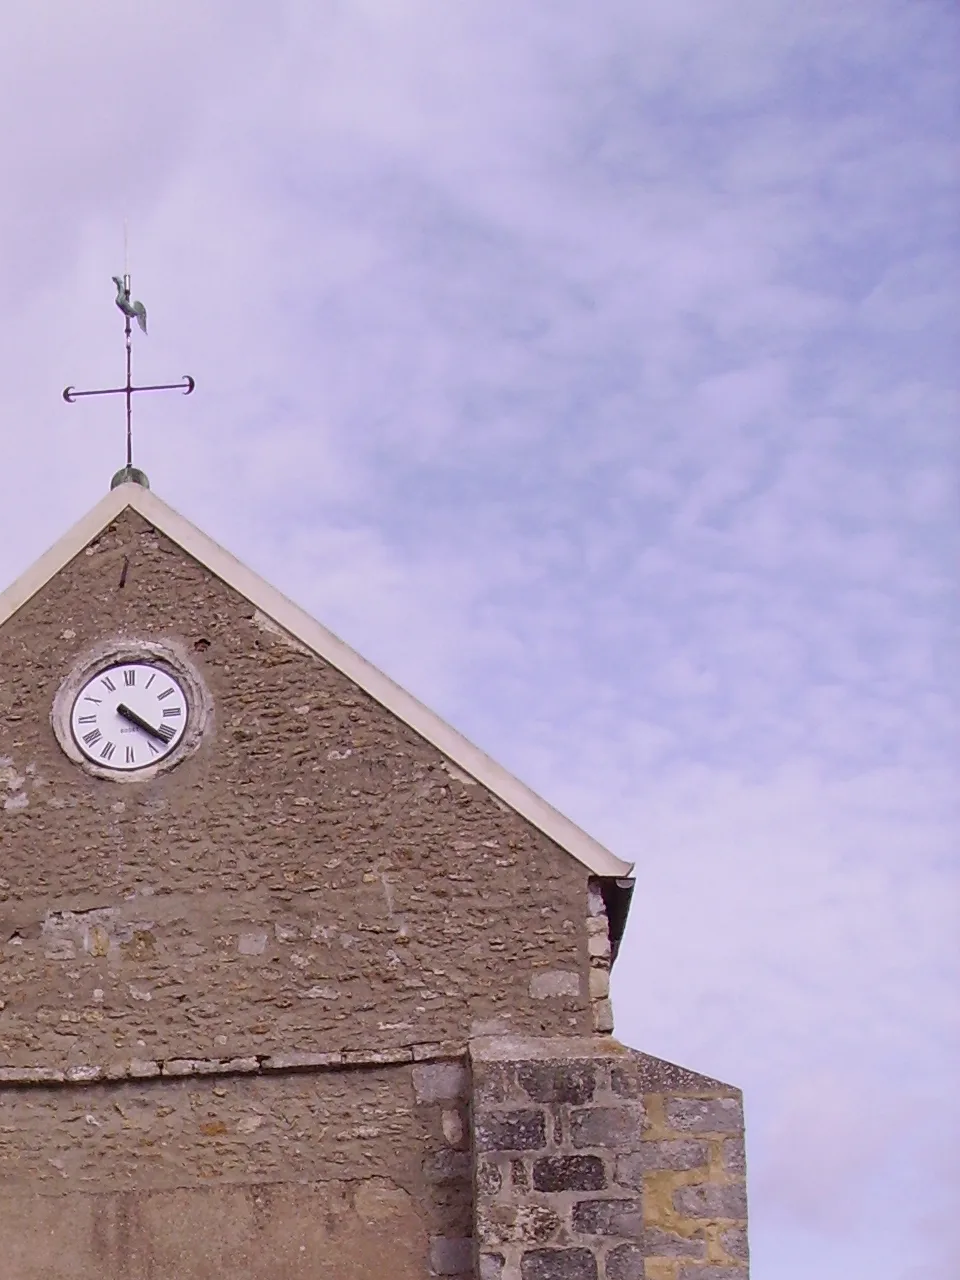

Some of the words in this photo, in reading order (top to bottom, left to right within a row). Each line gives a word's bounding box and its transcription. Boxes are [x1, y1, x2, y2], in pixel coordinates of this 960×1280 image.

[100, 676, 117, 693] XI
[123, 669, 136, 686] XII
[145, 673, 156, 690] I
[157, 687, 175, 701] II
[78, 714, 97, 724] IX
[162, 707, 182, 718] III
[81, 727, 104, 749] VIII
[99, 741, 117, 761] VII
[125, 746, 136, 764] VI
